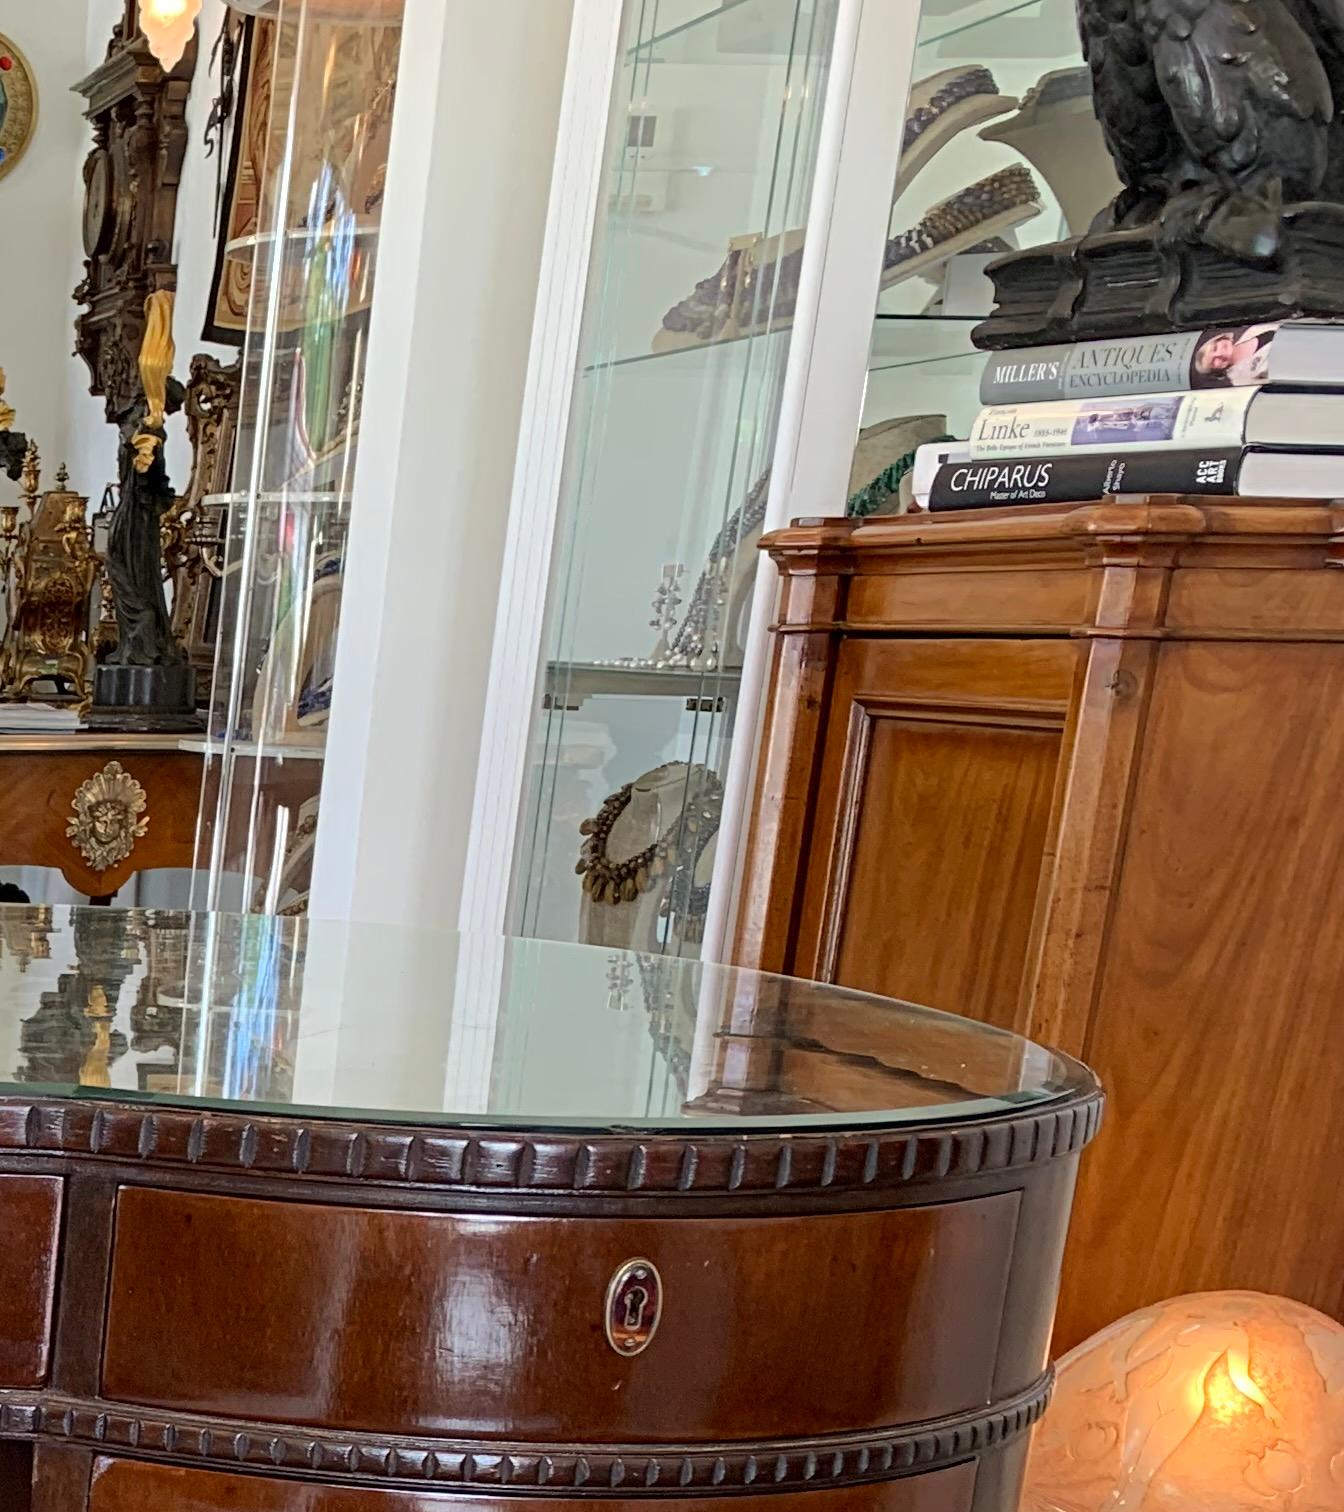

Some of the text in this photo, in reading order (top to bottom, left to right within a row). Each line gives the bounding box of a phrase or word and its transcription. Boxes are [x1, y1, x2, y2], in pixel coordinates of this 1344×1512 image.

[1072, 342, 1177, 370] ANTIQUES
[993, 361, 1060, 384] MILLER'S
[1070, 368, 1170, 388] ENCYCLOPEDIA
[979, 416, 1030, 440] Linke
[950, 463, 1052, 491] CHIPARUS
[1102, 459, 1117, 494] Alberto
[1196, 460, 1210, 483] ACC
[1206, 460, 1220, 483] ART
[990, 489, 1047, 500] Master of Art Deco
